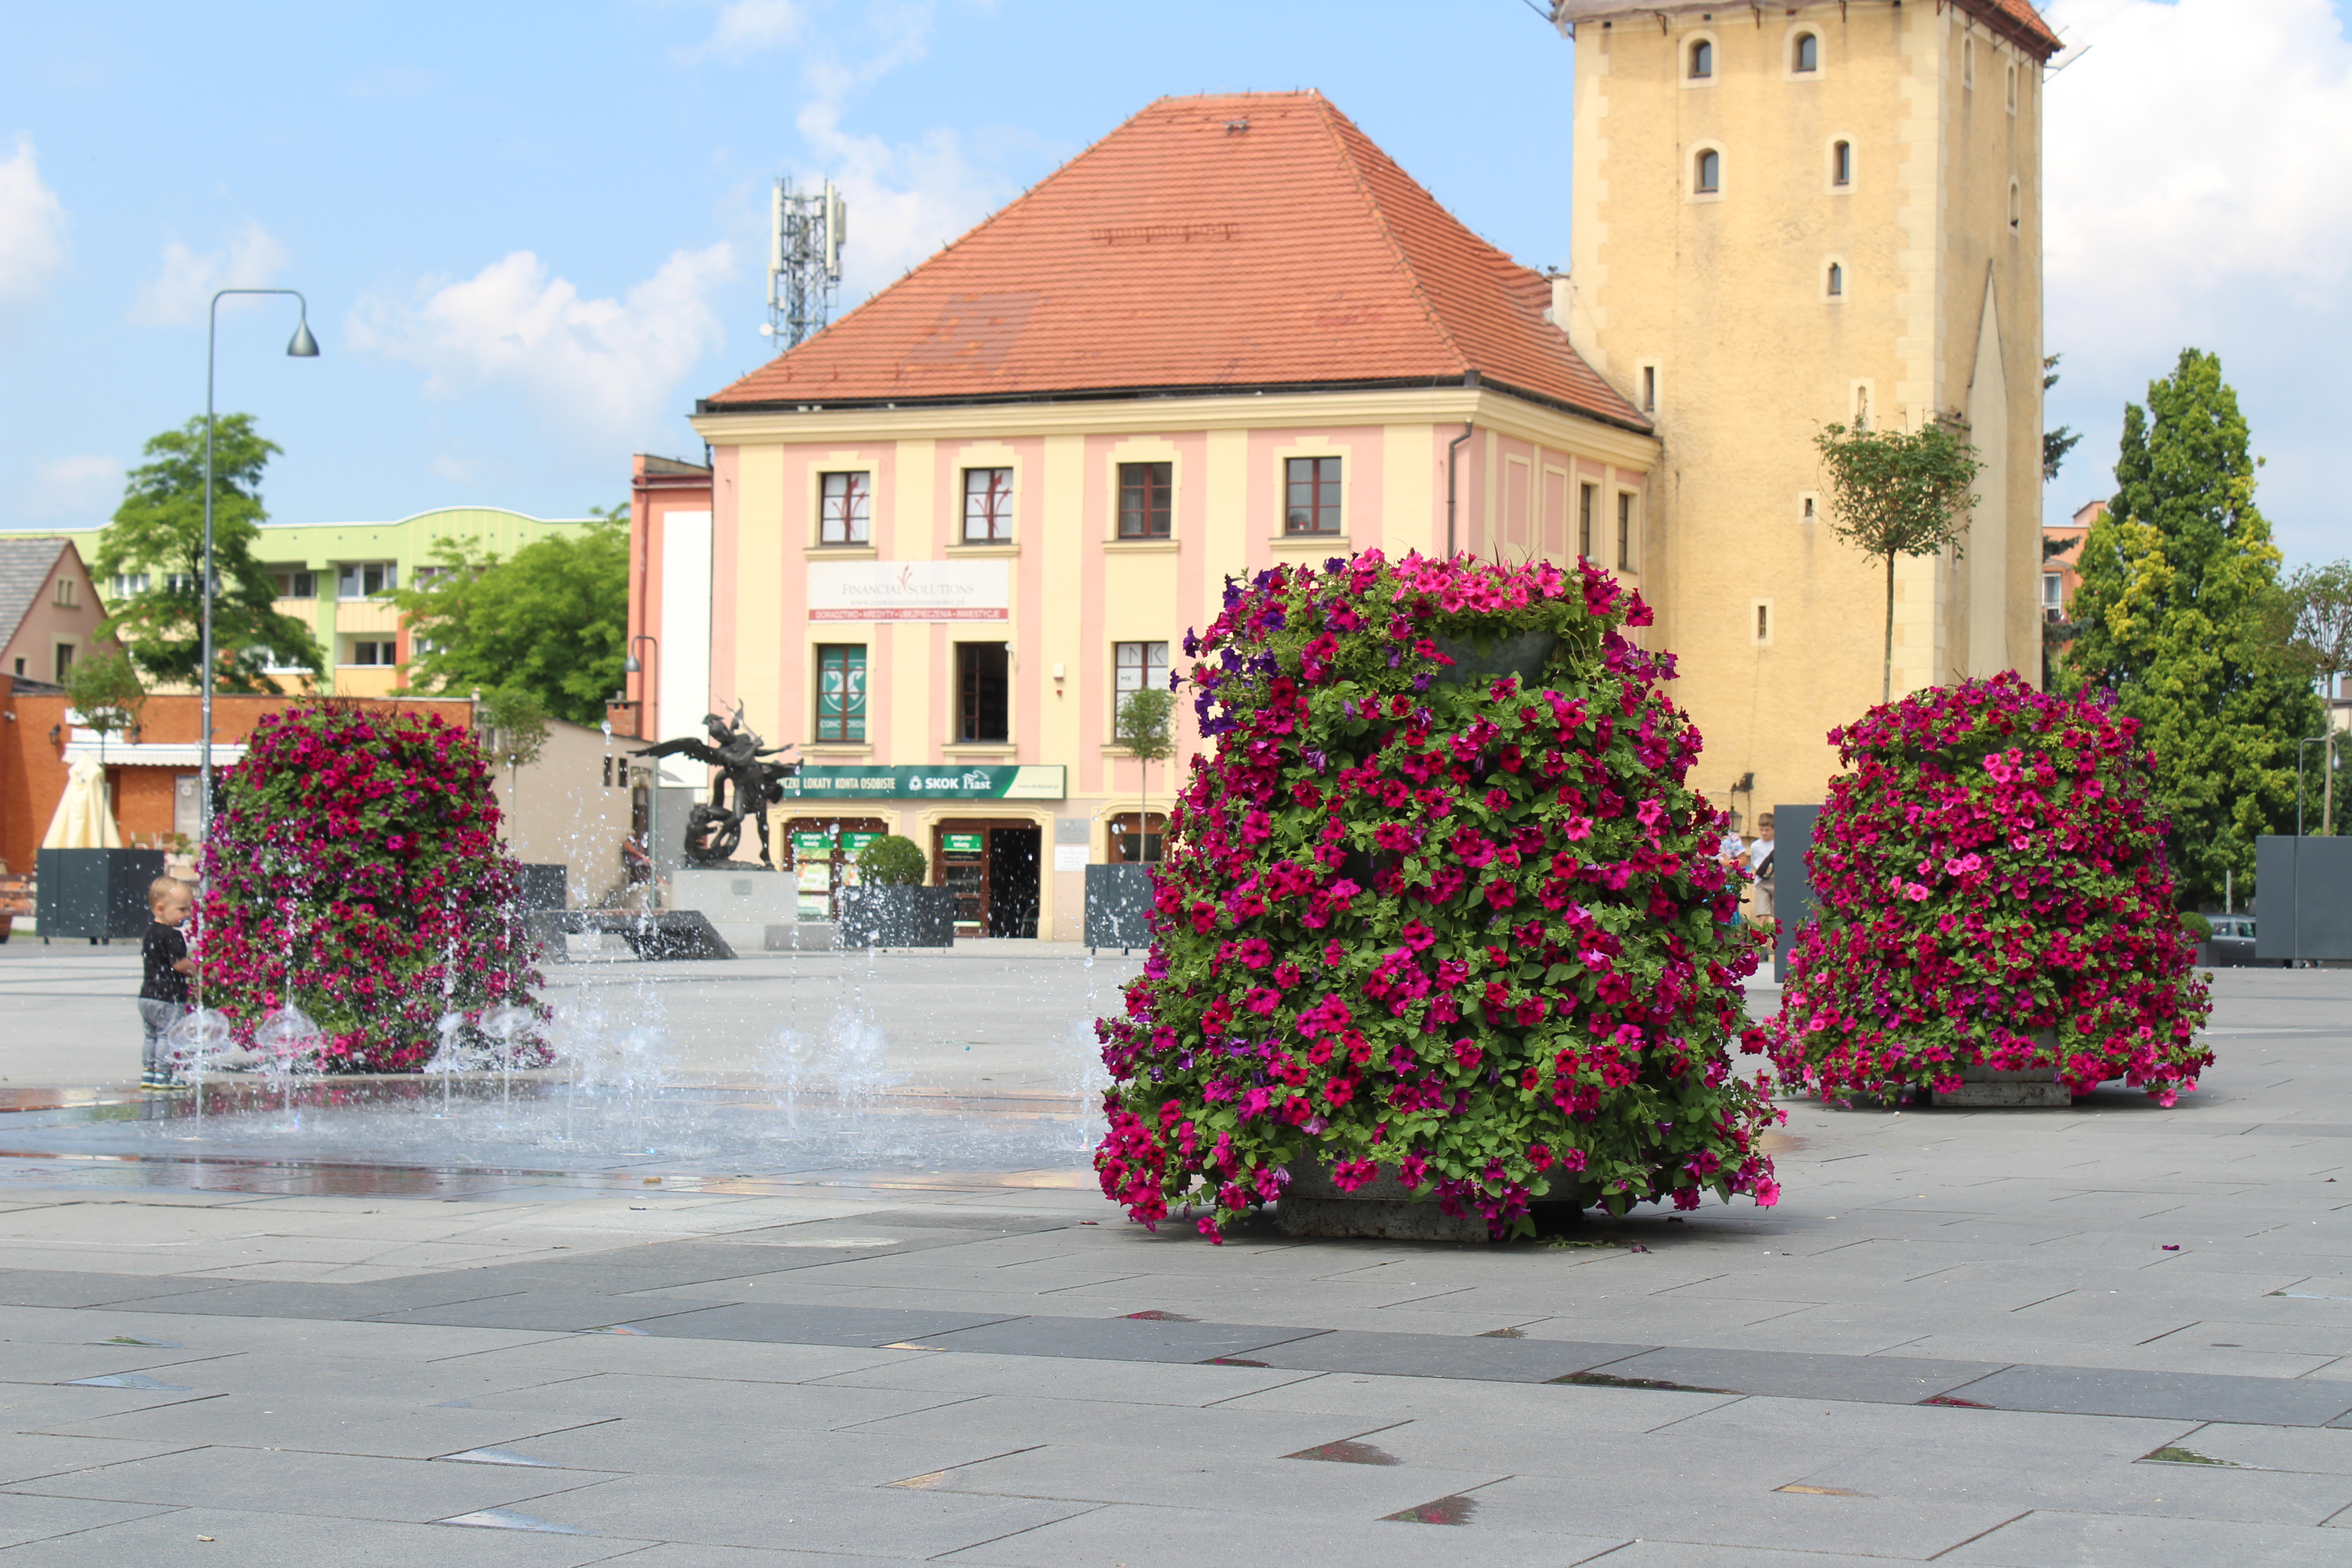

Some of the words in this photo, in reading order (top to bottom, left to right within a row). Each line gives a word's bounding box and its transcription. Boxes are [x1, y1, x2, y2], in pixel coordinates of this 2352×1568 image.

[843, 583, 903, 595] FINANCIAL
[907, 583, 974, 595] SOLUTIONS
[804, 778, 832, 789] LOKATY
[835, 778, 859, 789] KONTA
[861, 778, 896, 789] OSOBISTE
[925, 777, 960, 789] SKOK
[962, 774, 992, 789] Piast
